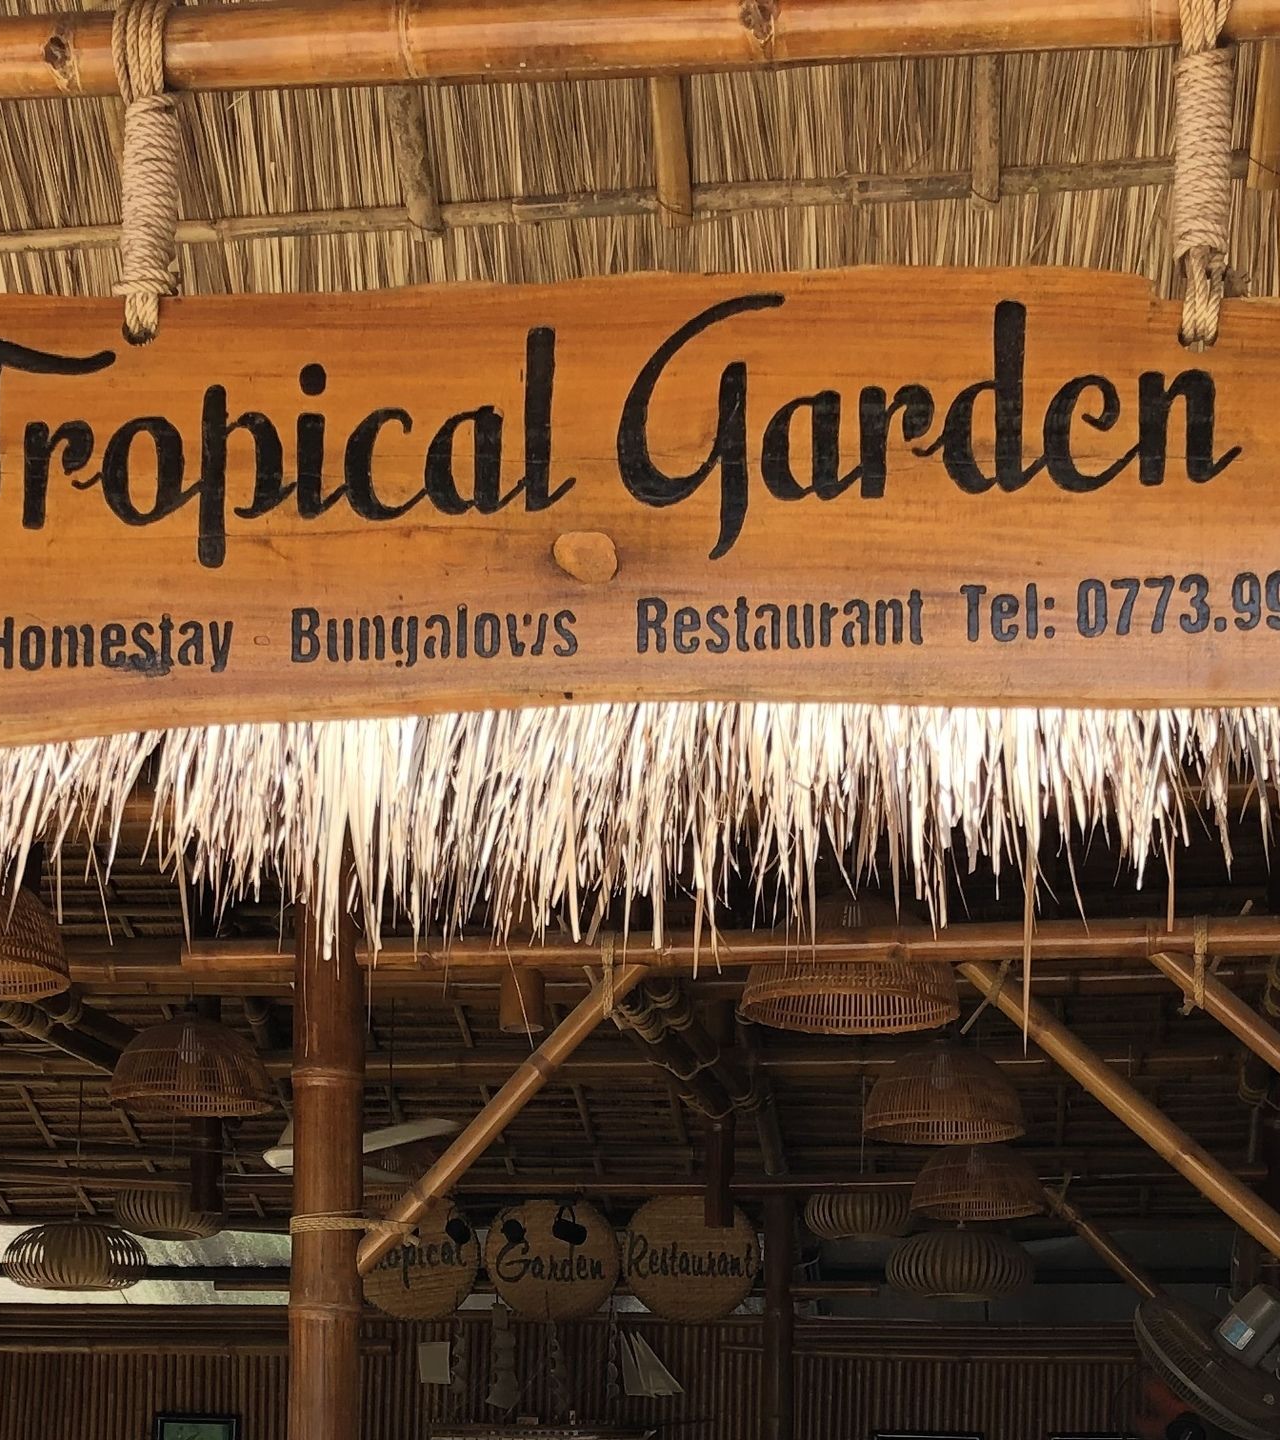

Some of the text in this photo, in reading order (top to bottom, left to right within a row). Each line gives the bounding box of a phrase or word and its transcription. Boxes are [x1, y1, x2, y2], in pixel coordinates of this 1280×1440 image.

[615, 292, 1242, 560] Garden
[291, 604, 578, 667] Bungalows
[636, 590, 923, 654] Restaurant
[959, 583, 1056, 642] Tel:
[496, 1239, 606, 1283] Garden
[626, 1232, 755, 1279] Restaurant
